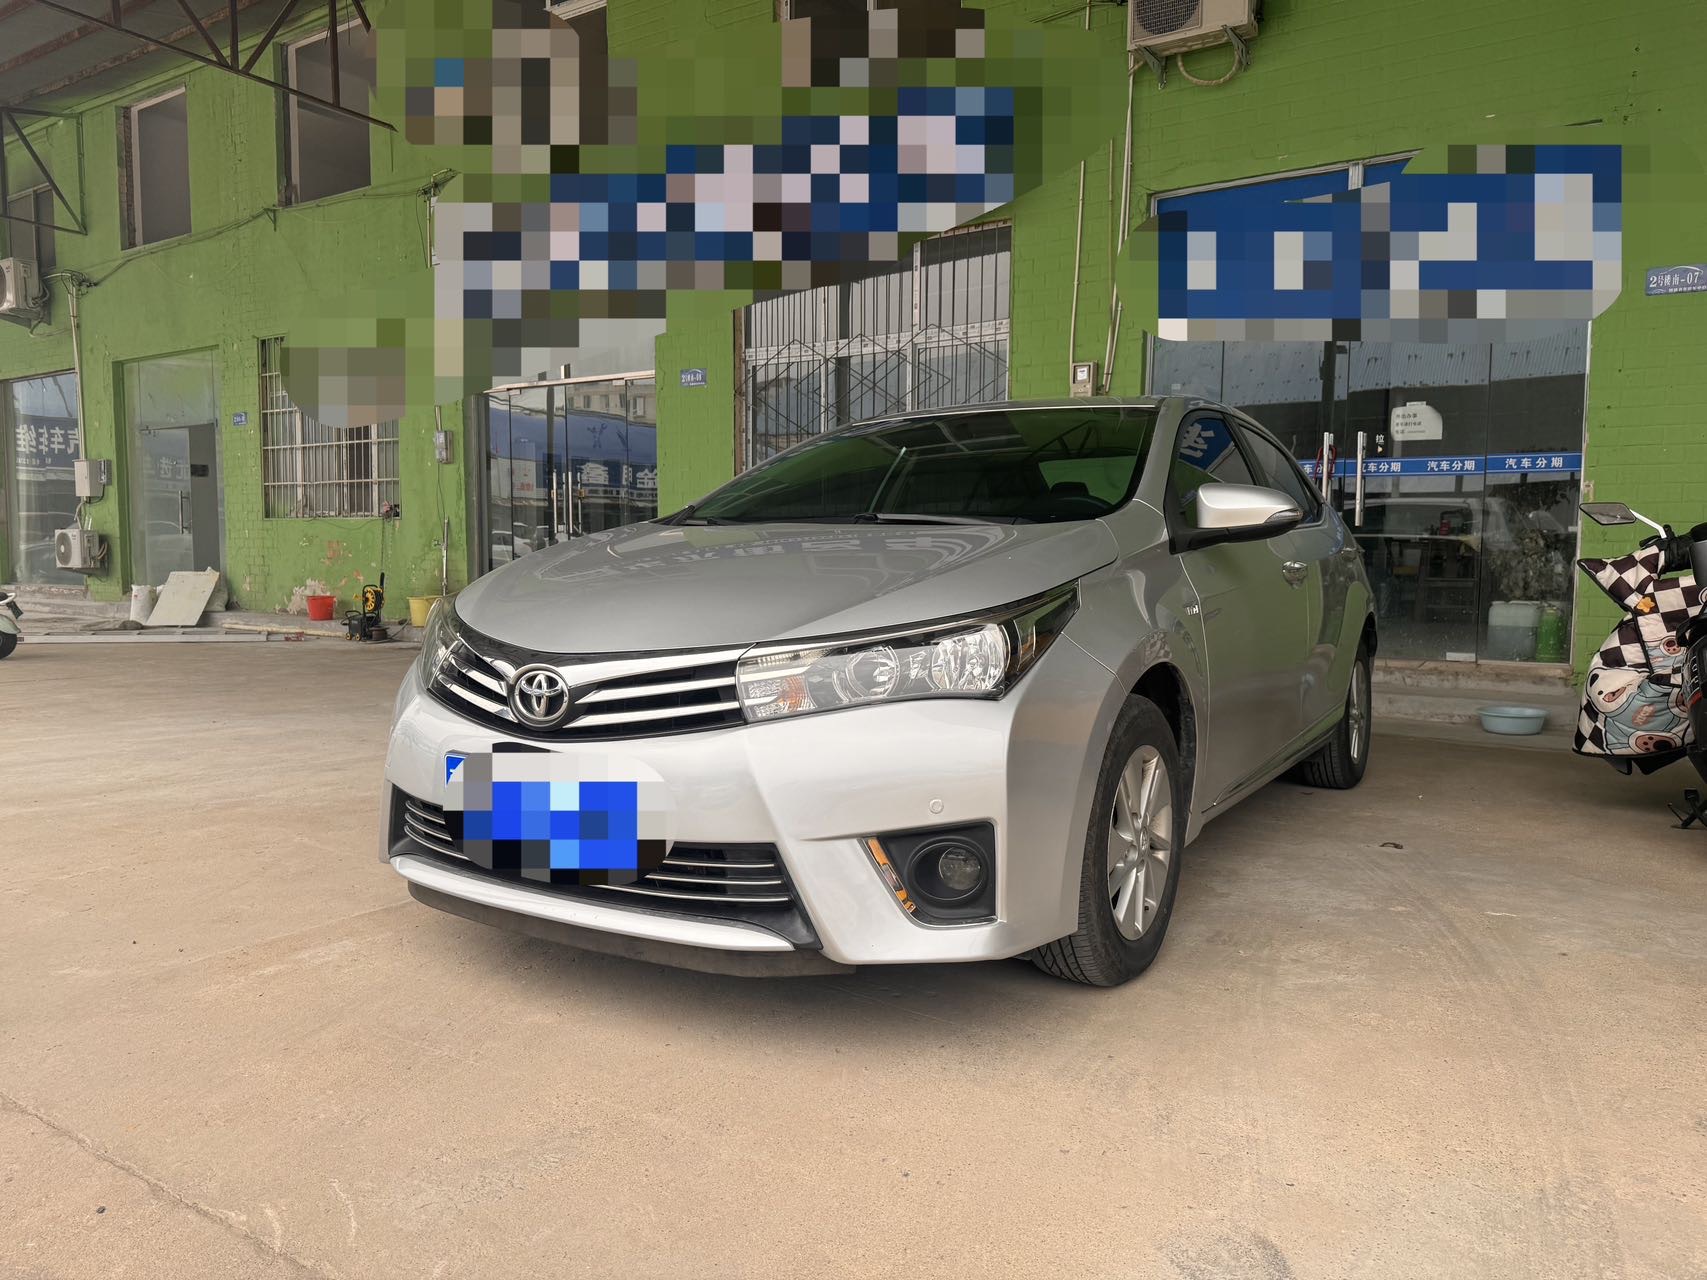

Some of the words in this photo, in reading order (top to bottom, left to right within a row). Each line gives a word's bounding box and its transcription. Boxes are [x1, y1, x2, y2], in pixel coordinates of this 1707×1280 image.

[1375, 434, 1385, 444] 拉
[1427, 459, 1475, 472] 汽车分期
[1505, 456, 1563, 469] 汽车分期
